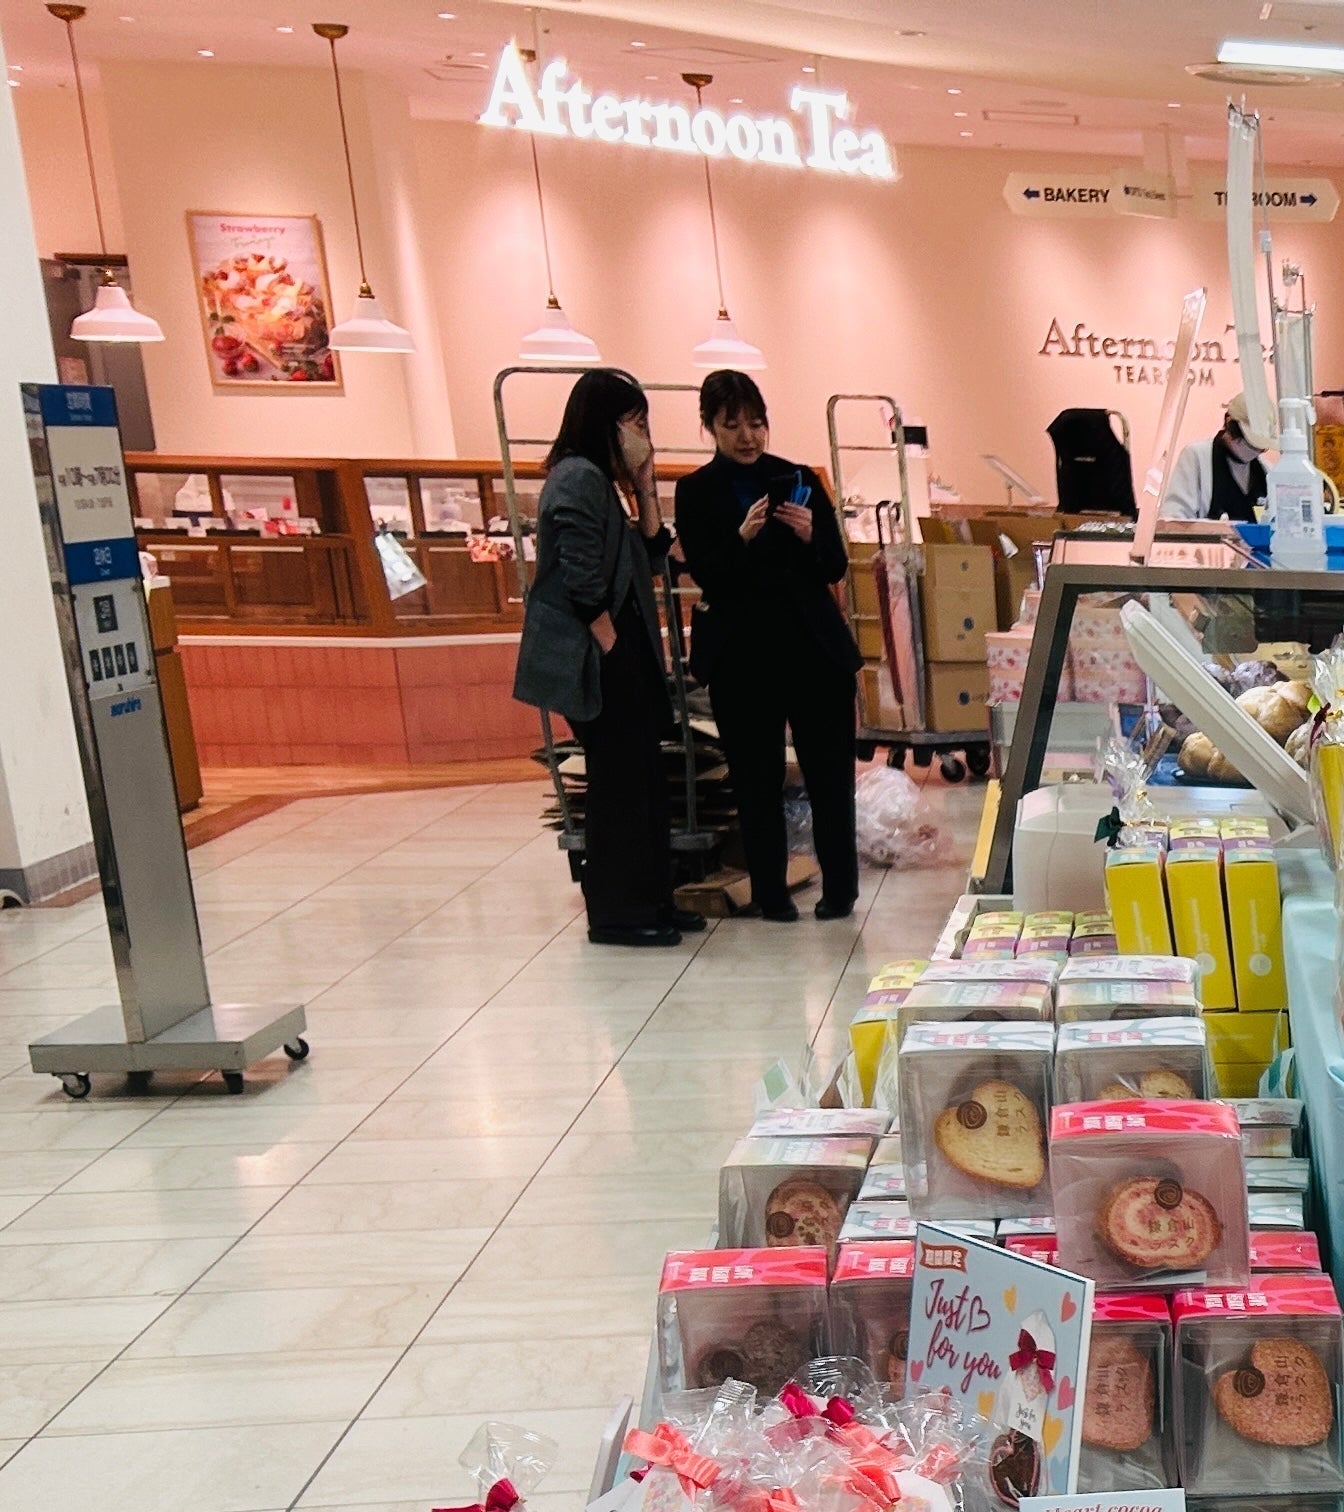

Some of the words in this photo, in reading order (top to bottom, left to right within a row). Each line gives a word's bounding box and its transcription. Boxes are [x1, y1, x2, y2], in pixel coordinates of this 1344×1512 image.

[478, 39, 802, 167] Afternoon
[790, 85, 898, 181] Tea
[1044, 188, 1110, 204] BAKERY
[926, 1279, 969, 1333] Just
[927, 1320, 960, 1369] for
[964, 1353, 1001, 1393] you
